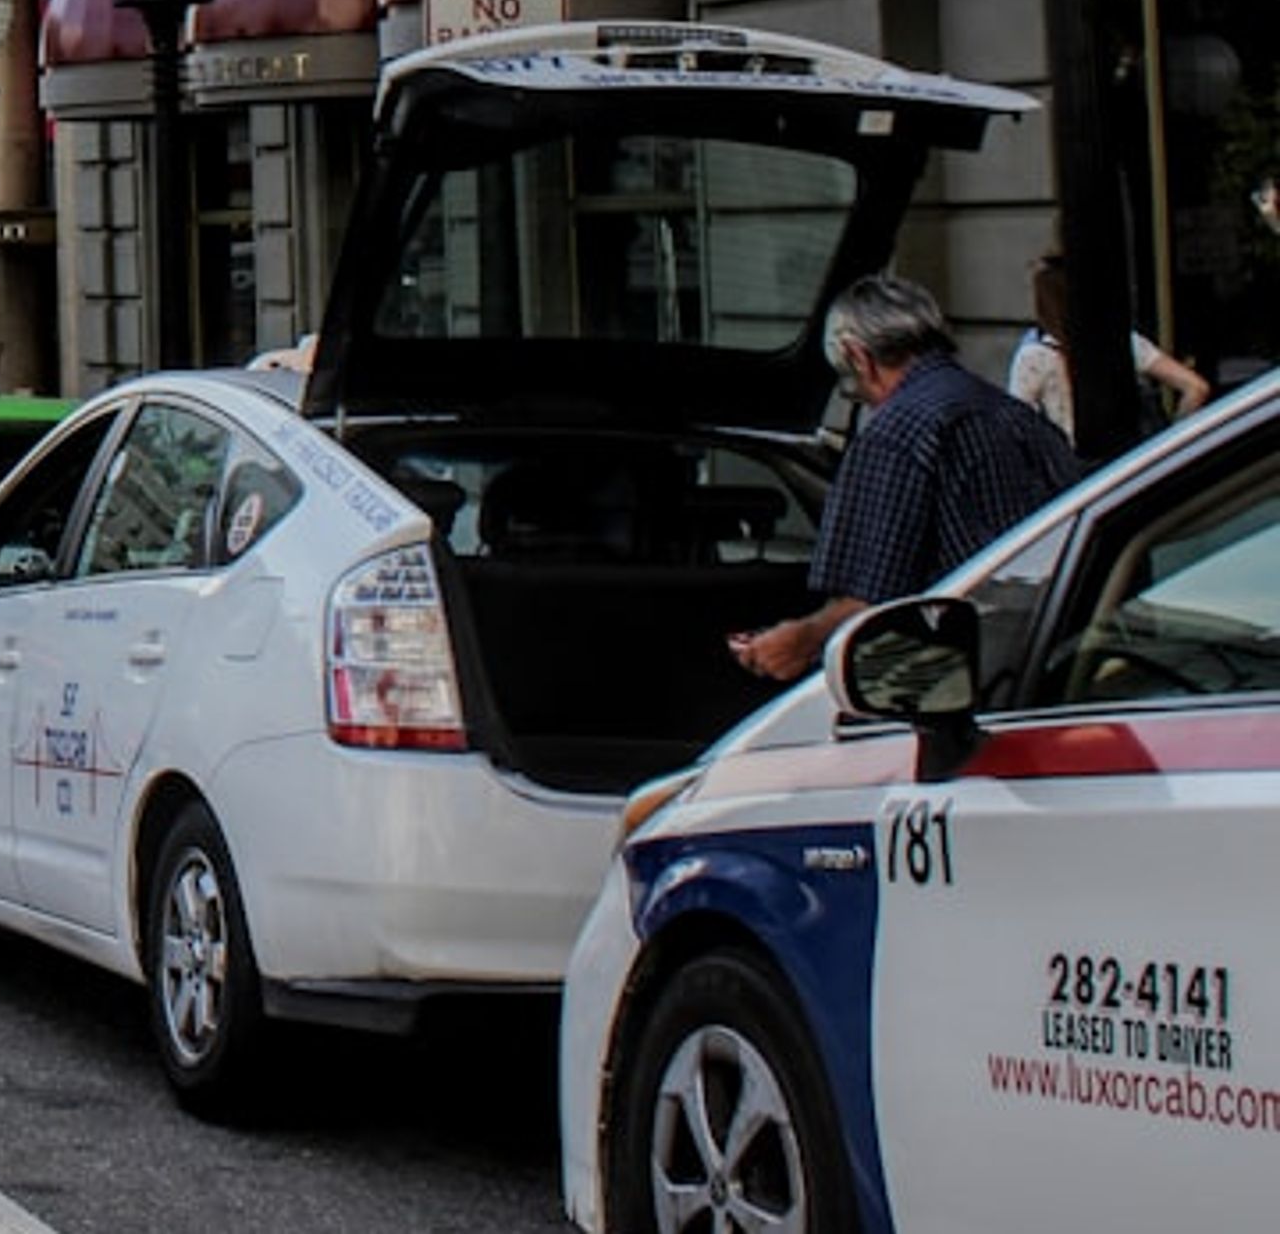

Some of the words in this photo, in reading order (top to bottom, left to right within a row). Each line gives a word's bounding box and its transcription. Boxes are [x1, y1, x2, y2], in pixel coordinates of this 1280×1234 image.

[885, 798, 954, 884] 781
[1048, 952, 1229, 1023] 282-4141
[1043, 1012, 1115, 1055] LEASED
[1123, 1020, 1149, 1060] TO
[1157, 1024, 1234, 1071] DRIVER
